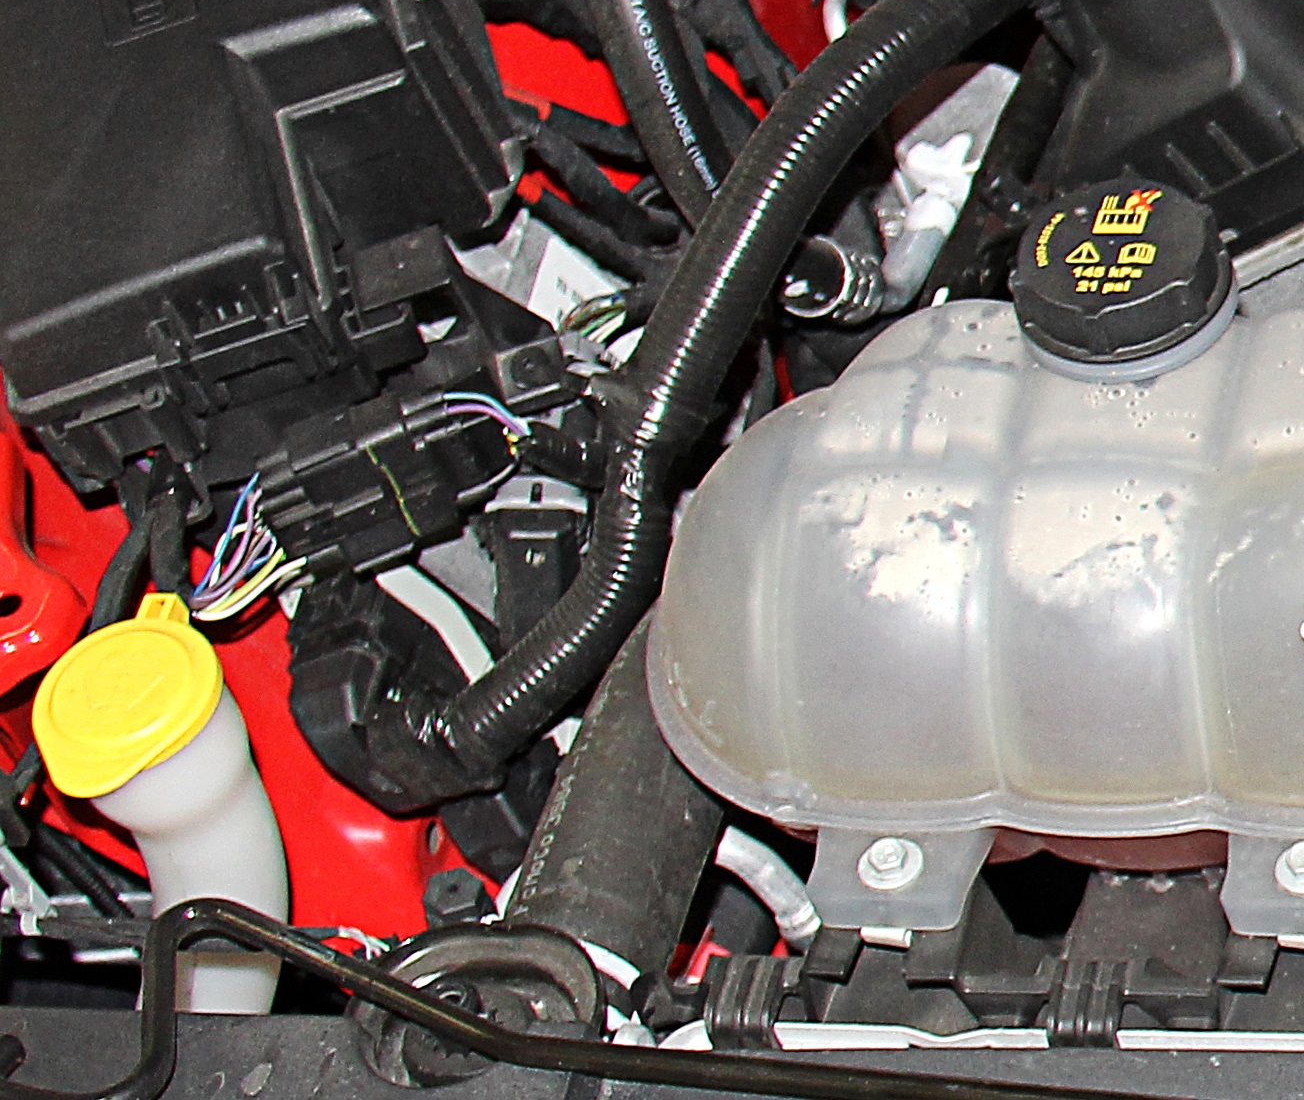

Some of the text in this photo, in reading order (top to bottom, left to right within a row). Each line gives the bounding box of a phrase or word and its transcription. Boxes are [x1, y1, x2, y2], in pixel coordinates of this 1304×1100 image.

[643, 36, 678, 106] SUCTION
[668, 103, 696, 147] HOSE
[1072, 265, 1144, 279] 145 kPa
[1075, 279, 1133, 295] 21 psi
